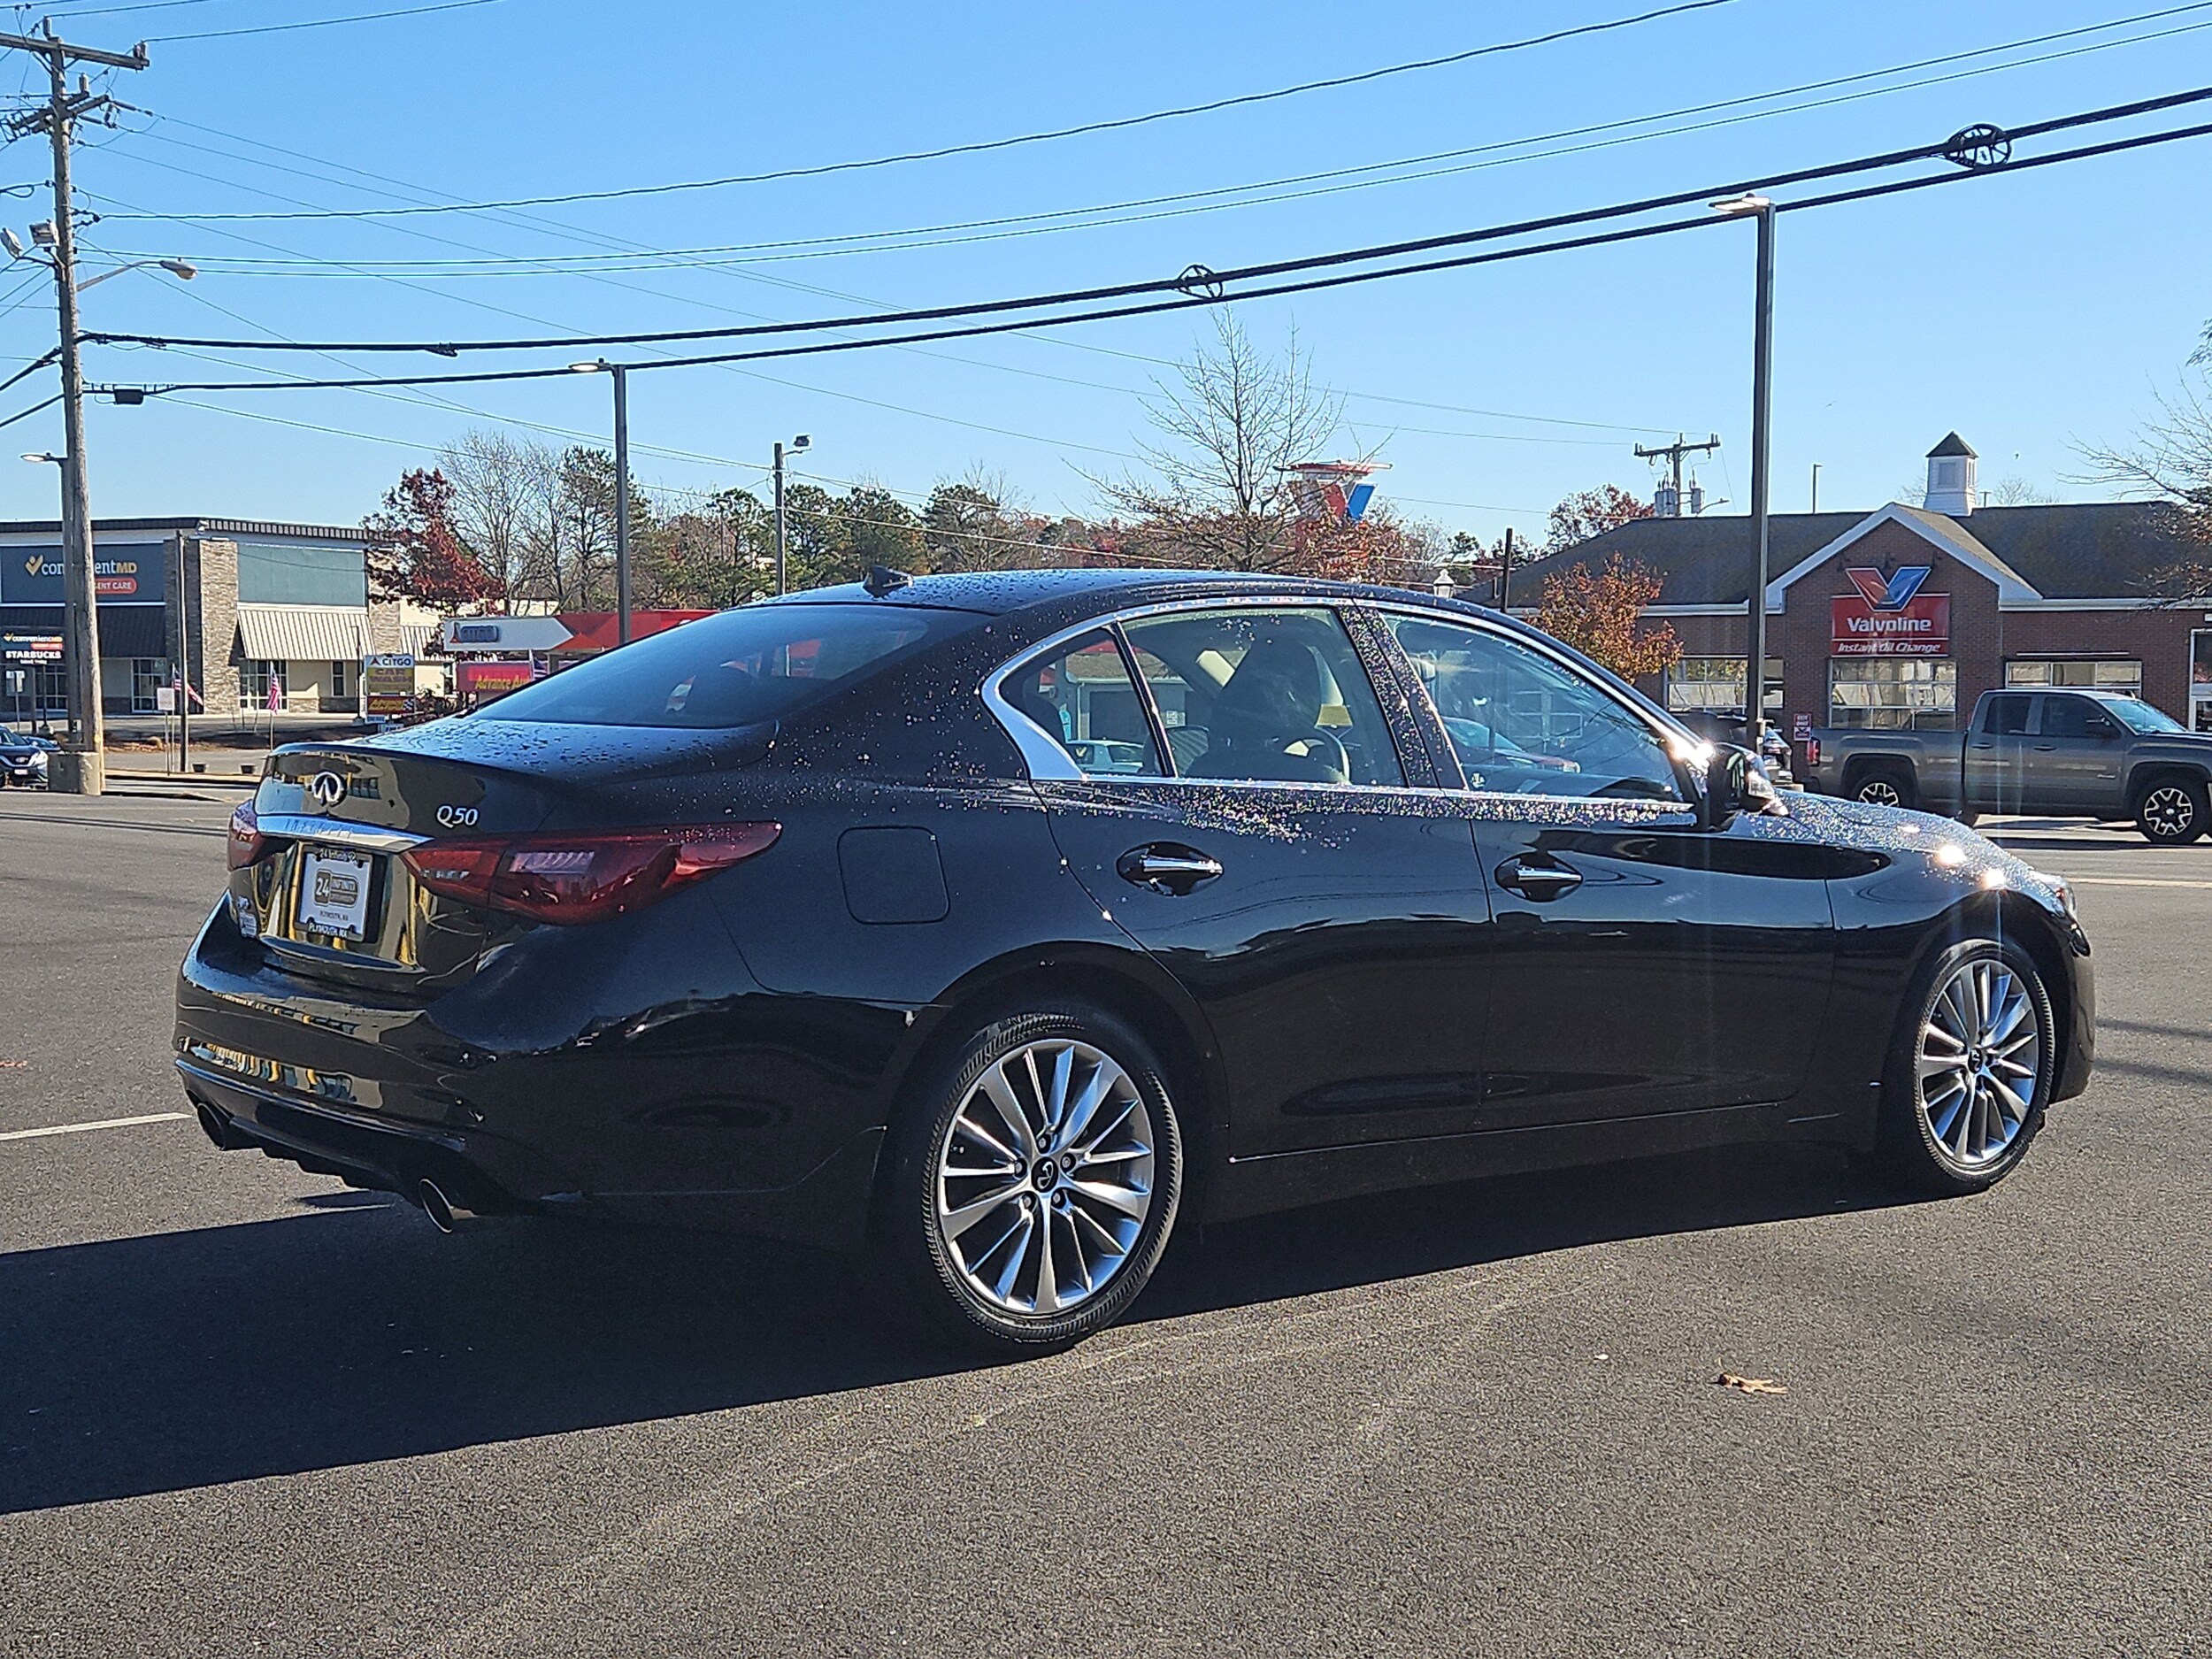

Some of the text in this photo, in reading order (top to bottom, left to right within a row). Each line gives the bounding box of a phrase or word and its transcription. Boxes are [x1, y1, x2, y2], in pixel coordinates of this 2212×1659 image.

[42, 559, 137, 575] conentMD
[1847, 617, 1932, 632] Valvoline
[5, 650, 62, 659] STARBUCKS
[1838, 642, 1941, 654] Instant Oil Change
[382, 657, 411, 666] CITGO
[436, 805, 479, 828] Q50
[315, 877, 330, 897] 24
